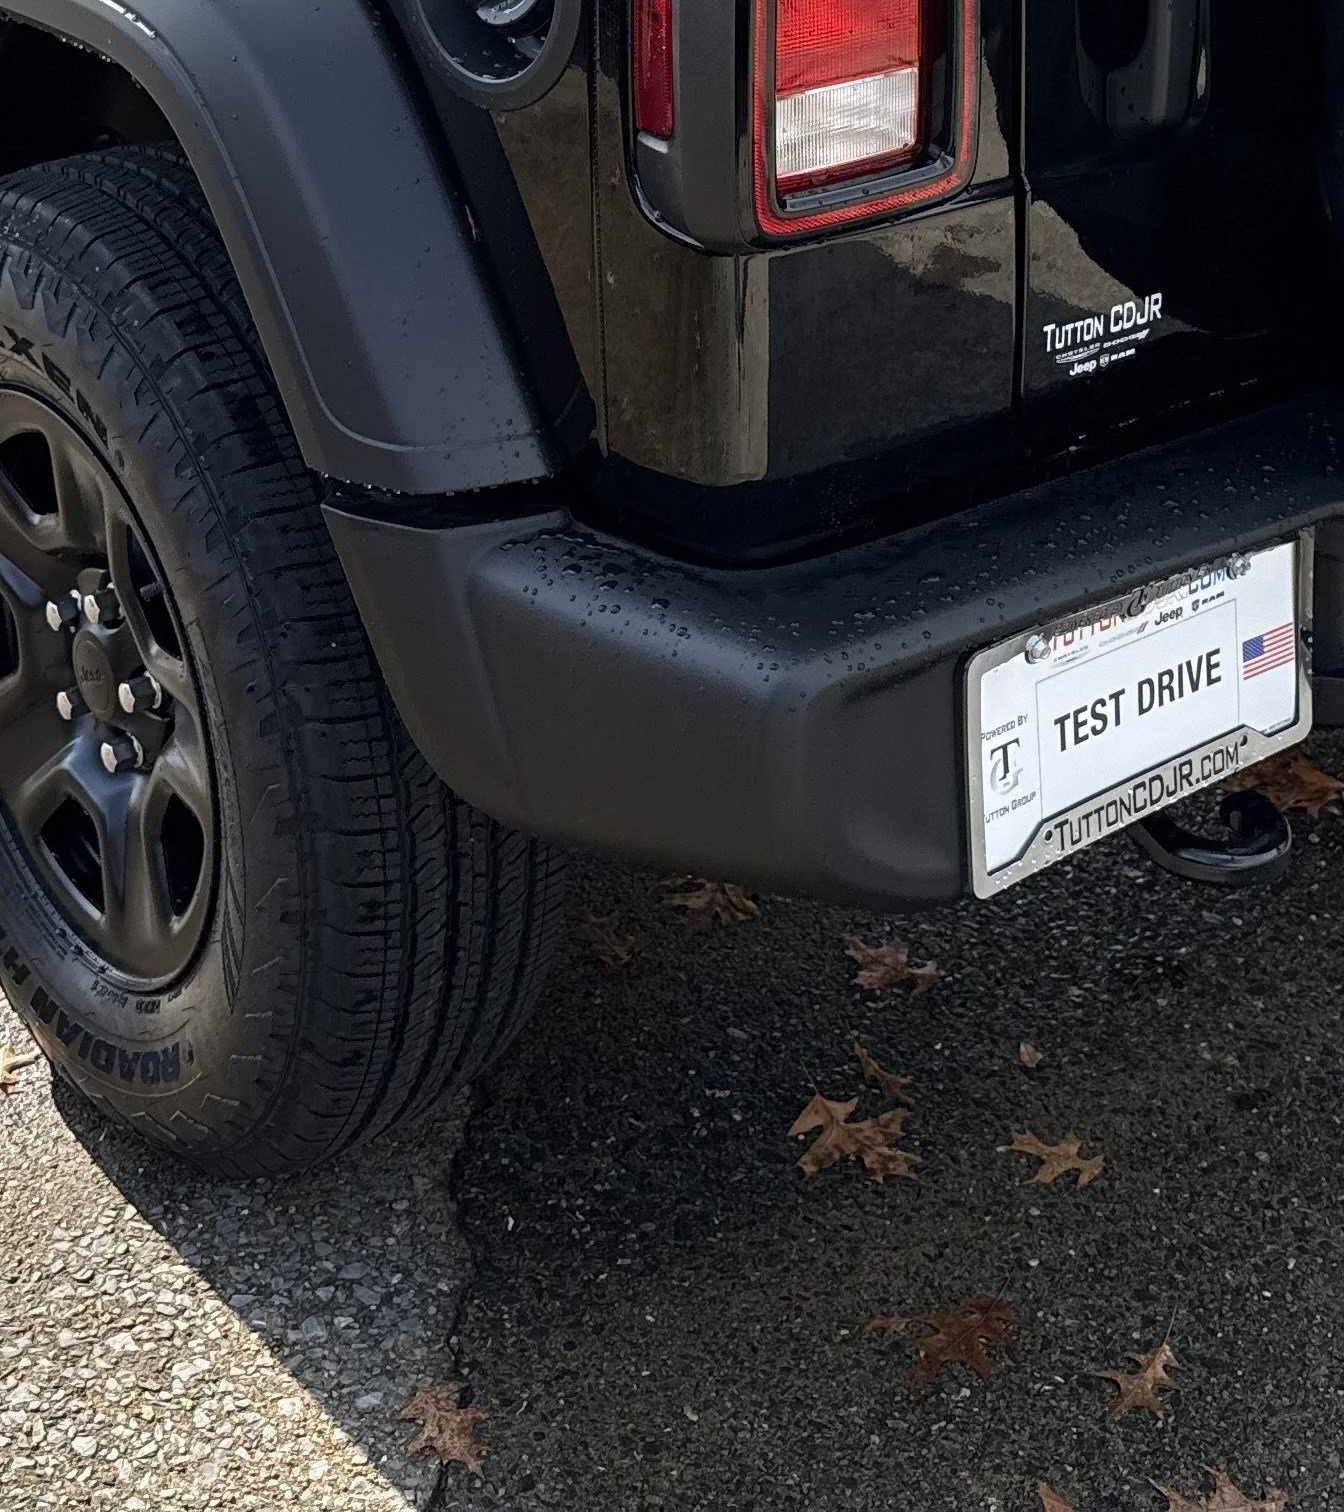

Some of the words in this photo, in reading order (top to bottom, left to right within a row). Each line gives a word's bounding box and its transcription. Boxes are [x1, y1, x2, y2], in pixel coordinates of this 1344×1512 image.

[1043, 314, 1104, 353] TUTTON
[1109, 292, 1163, 333] CDJR
[1069, 359, 1097, 376] Jeep
[1155, 606, 1184, 625] Jeep
[1053, 688, 1126, 753] TEST
[1137, 647, 1223, 719] DRIVE
[981, 720, 1016, 741] POWERED
[984, 803, 1010, 824] UTTON
[1011, 790, 1037, 811] GROUP
[1054, 742, 1240, 852] TUTTONCDJR.COM
[30, 986, 181, 1086] ROADIAN
